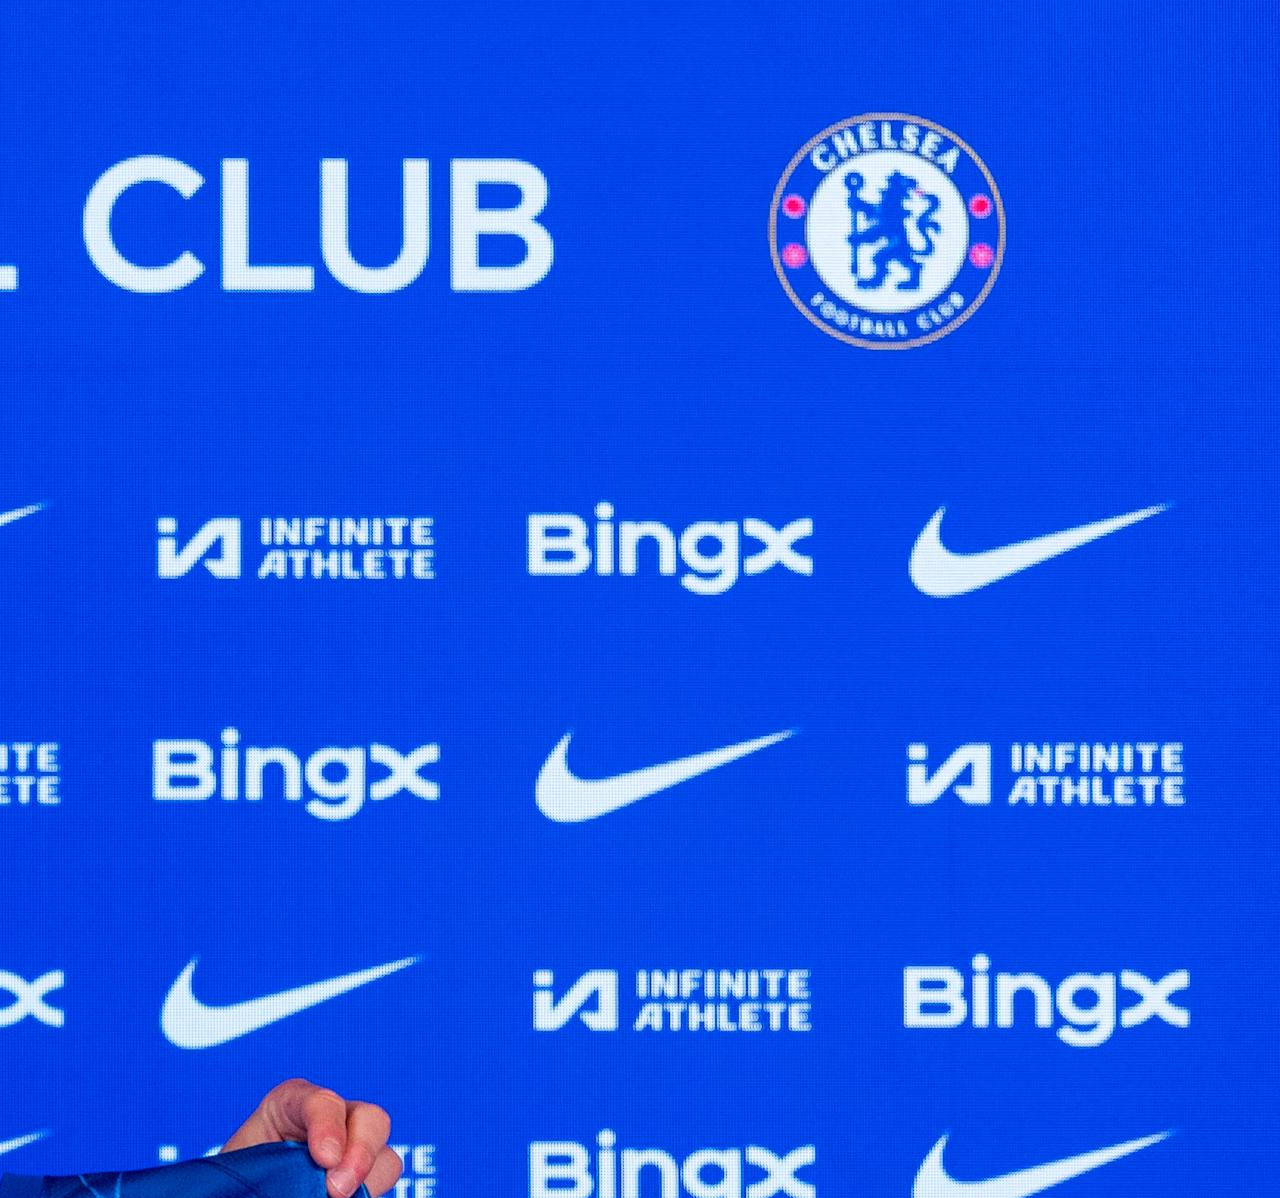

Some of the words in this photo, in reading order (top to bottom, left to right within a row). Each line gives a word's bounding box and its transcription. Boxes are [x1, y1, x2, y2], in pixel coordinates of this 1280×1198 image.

[811, 121, 960, 174] CHELSEA
[84, 156, 555, 294] CLUB
[262, 519, 434, 546] INFINITE
[259, 551, 434, 580] ATHLETE
[1013, 744, 1184, 773] INFINITE
[1009, 777, 1184, 805] ATHLETE
[637, 971, 809, 1000] INFINITE
[637, 1004, 812, 1032] ATHLETE
